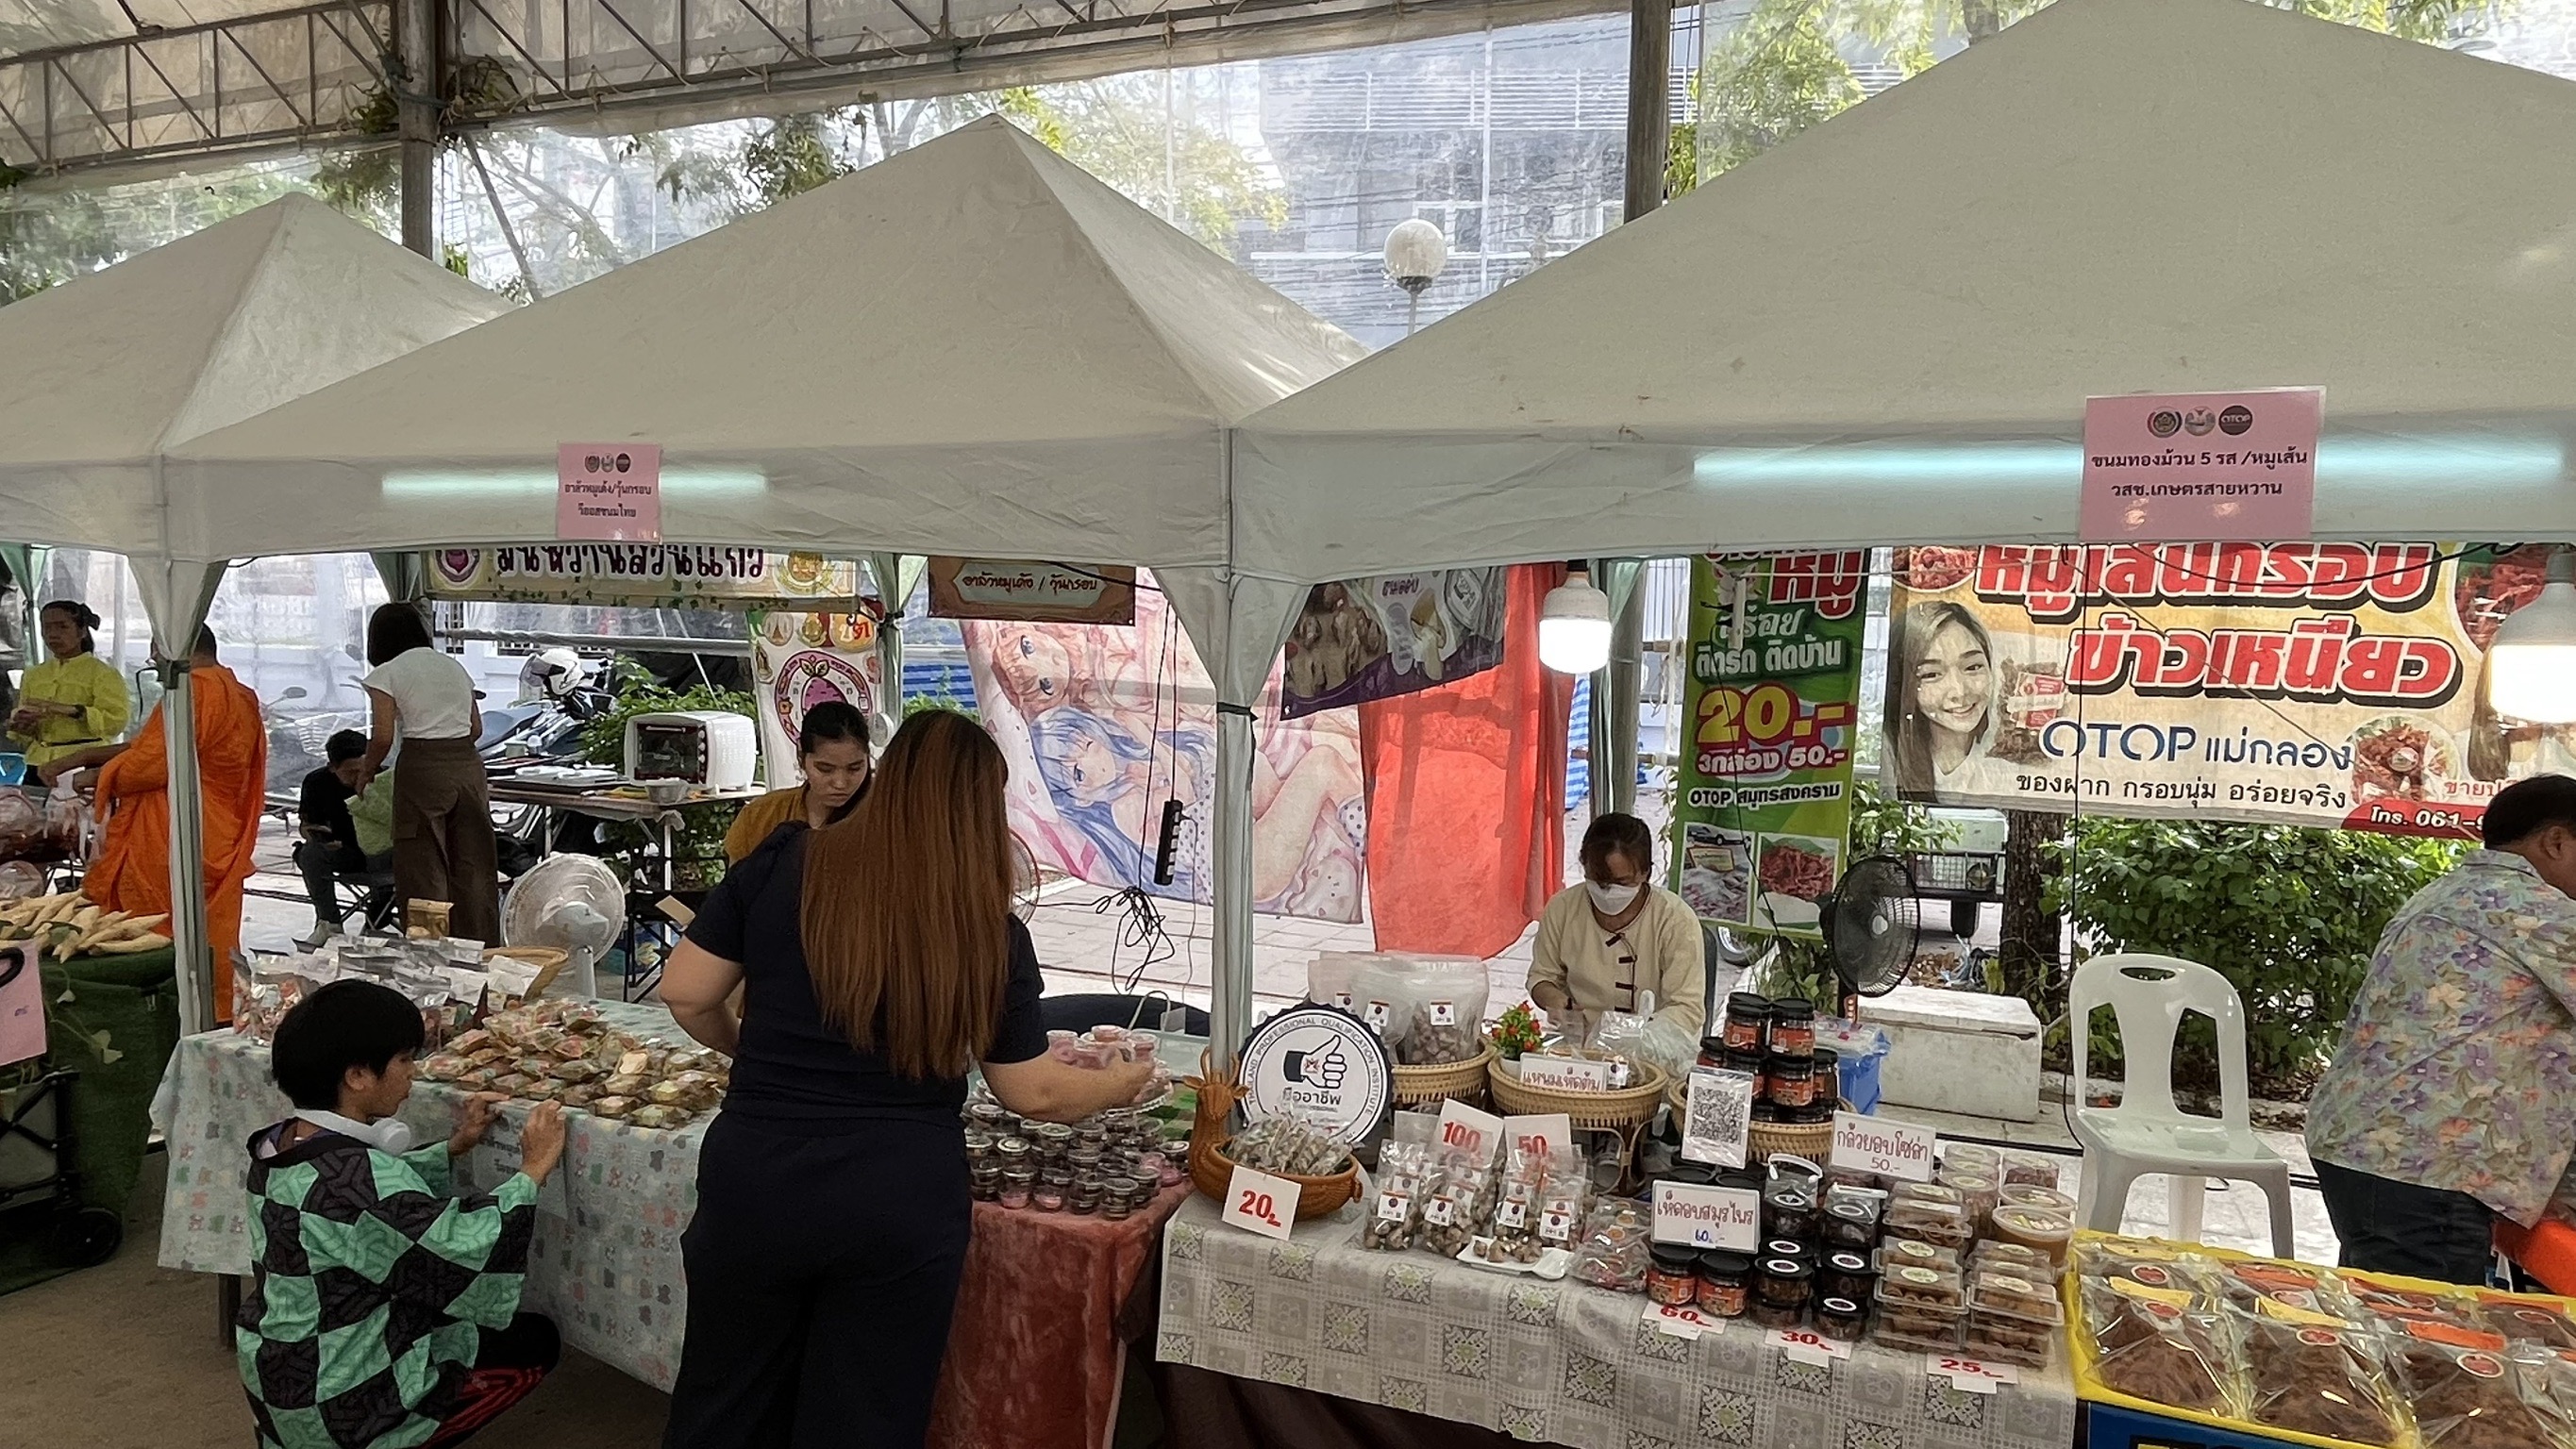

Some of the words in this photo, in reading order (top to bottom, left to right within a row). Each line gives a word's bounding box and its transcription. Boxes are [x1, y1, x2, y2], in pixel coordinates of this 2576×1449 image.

[2092, 449, 2196, 467] ขนมทองม้วน
[2200, 452, 2211, 465] 5
[2216, 452, 2237, 465] รส
[2112, 482, 2283, 497] วสช.เกษตรสายหวาน
[1765, 634, 1841, 672] ติดบ้าน
[2065, 615, 2459, 698] ข้าวเหนียว
[1698, 686, 1845, 743] 20.-
[1789, 745, 1845, 766] 50.-
[2042, 720, 2197, 761] OTOP
[2205, 725, 2351, 770] แม่กลอง
[1690, 790, 1731, 805] OTOP
[1736, 784, 1840, 808] สมุทรสงคราม
[2123, 776, 2216, 808] กรอบนุ่ม
[2229, 780, 2346, 808] อร่อยจริง
[2370, 806, 2407, 824] โทร.
[1256, 1018, 1316, 1057] PROFESSIONAL
[1321, 1018, 1375, 1063] QUALIFICATION
[1367, 1068, 1380, 1115] INSTITUTE
[1870, 1157, 1900, 1173] 50.-
